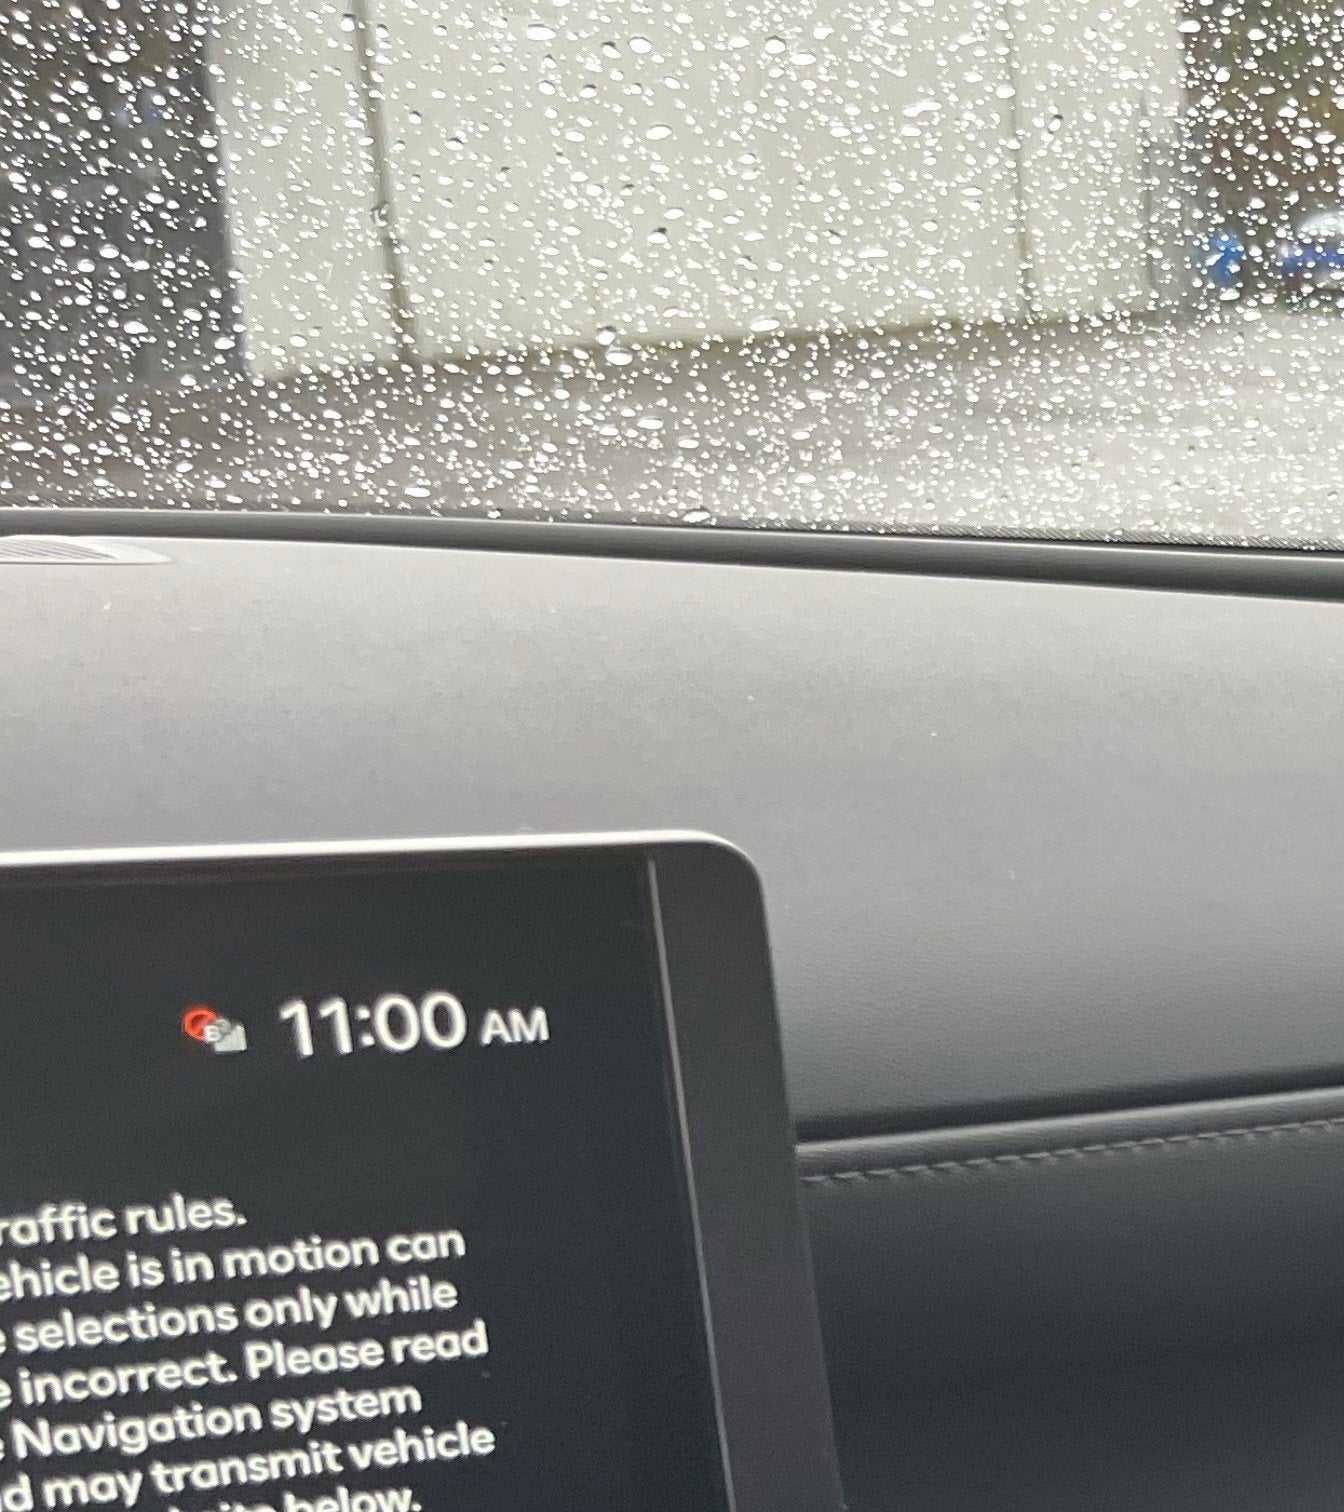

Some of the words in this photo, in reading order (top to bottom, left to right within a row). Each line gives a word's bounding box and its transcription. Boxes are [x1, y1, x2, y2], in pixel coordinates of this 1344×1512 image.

[279, 990, 467, 1057] 11:00
[480, 1006, 549, 1045] AM
[124, 1192, 247, 1235] rules.
[127, 1250, 165, 1287] is
[170, 1246, 215, 1284] in
[221, 1234, 379, 1278] motion
[386, 1229, 466, 1263] can
[14, 1302, 239, 1354] selections
[245, 1283, 338, 1329] only
[344, 1274, 458, 1318] while
[18, 1351, 238, 1406] incorrect.
[244, 1339, 385, 1379] Please
[391, 1317, 489, 1364] read
[12, 1401, 262, 1459] Navigation
[269, 1385, 422, 1434] system
[43, 1470, 143, 1508] may
[150, 1439, 343, 1495] transmit
[348, 1419, 496, 1470] vehicle
